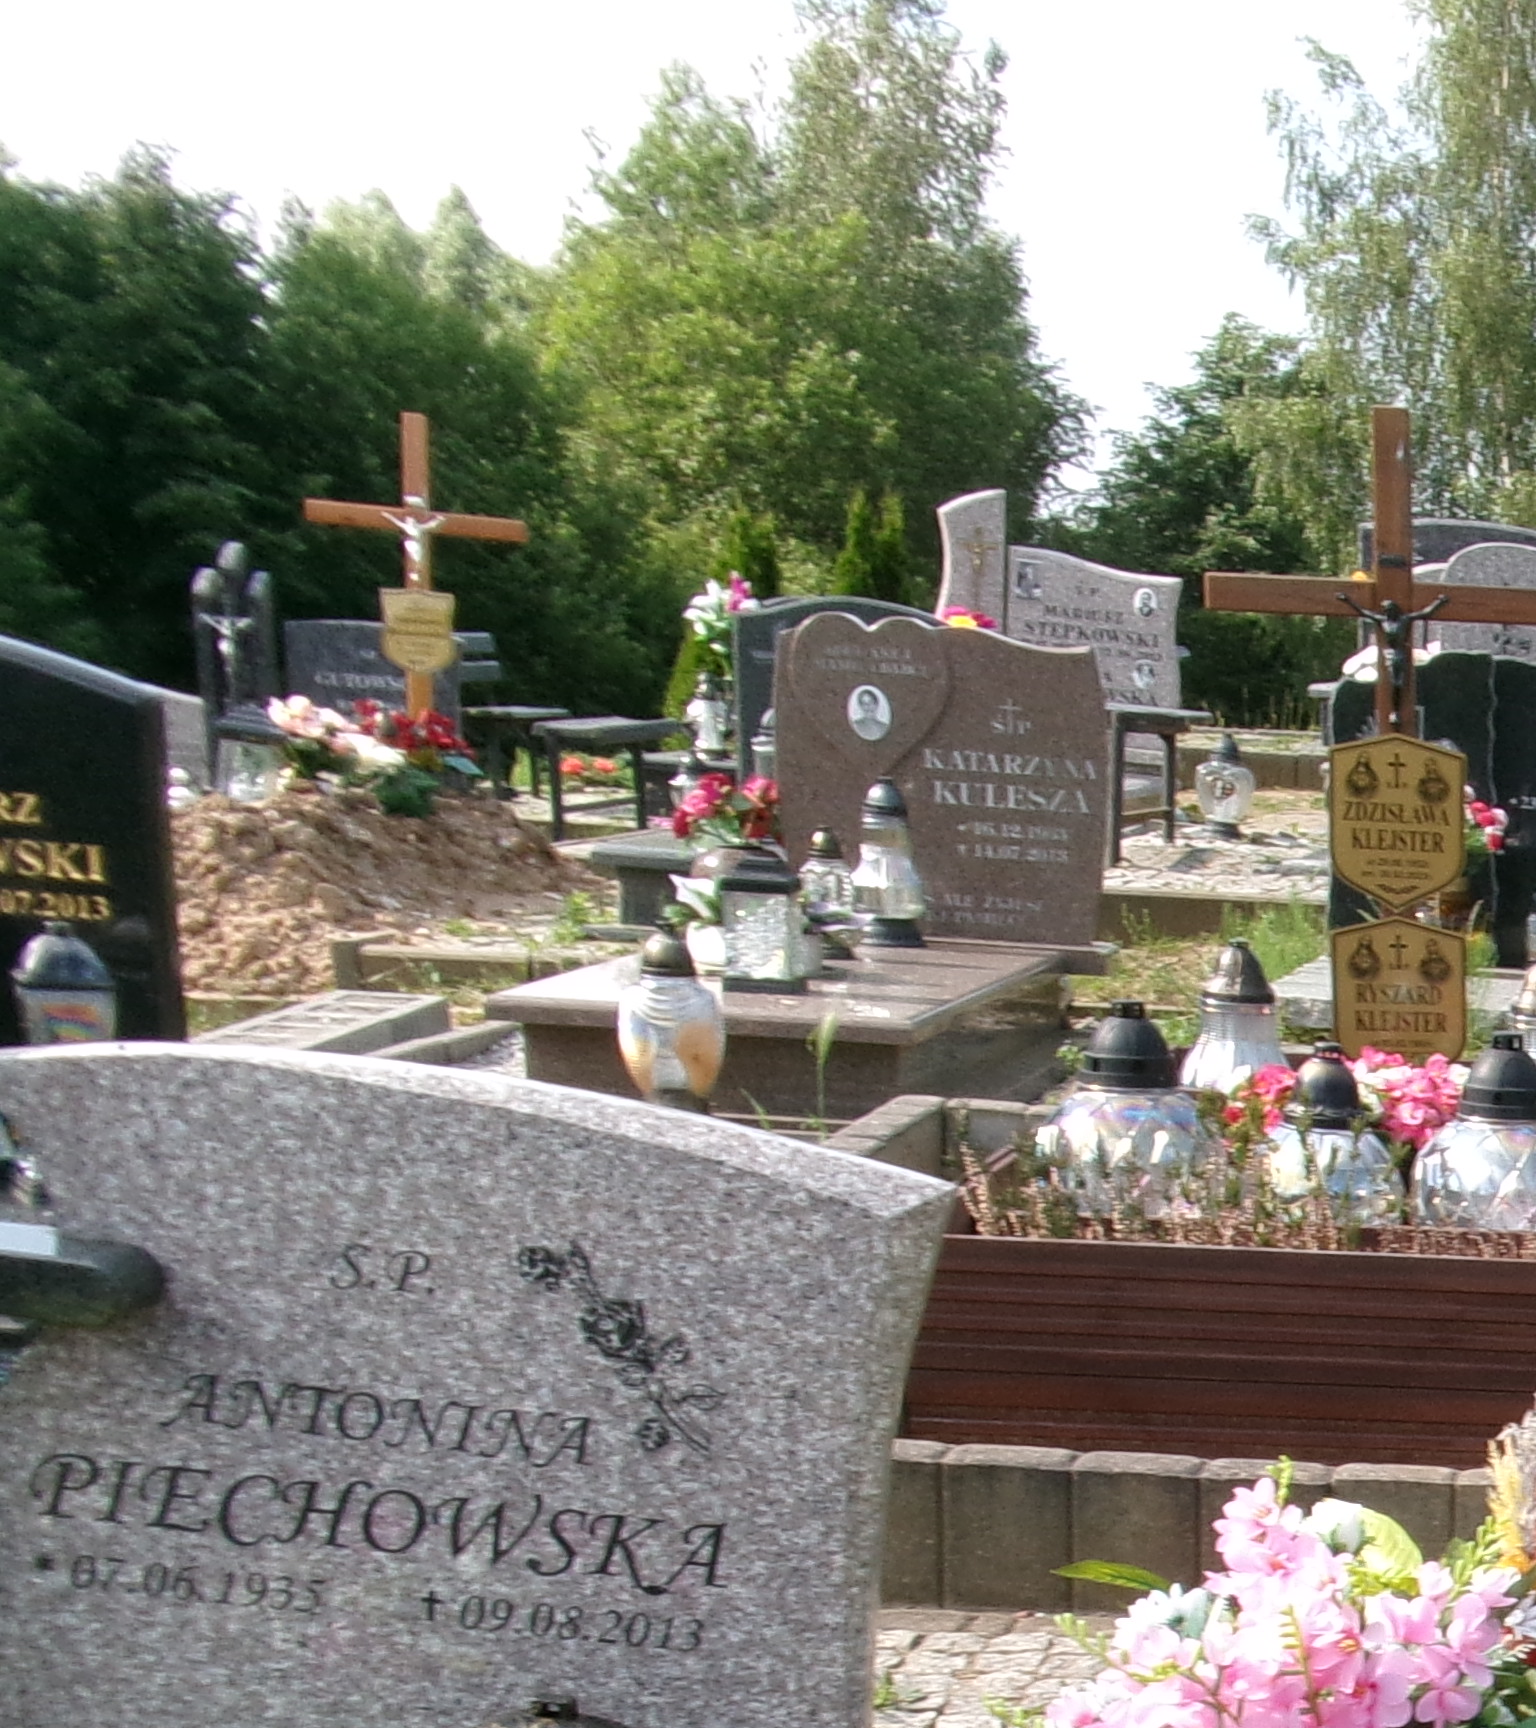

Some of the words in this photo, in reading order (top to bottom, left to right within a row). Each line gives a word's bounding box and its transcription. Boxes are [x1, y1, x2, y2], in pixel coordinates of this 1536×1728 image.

[923, 748, 1097, 780] KATARZYNA
[933, 780, 1091, 814] KULESZA
[160, 1372, 600, 1469] ANTONINA
[29, 1451, 732, 1596] PIECHOWSKA
